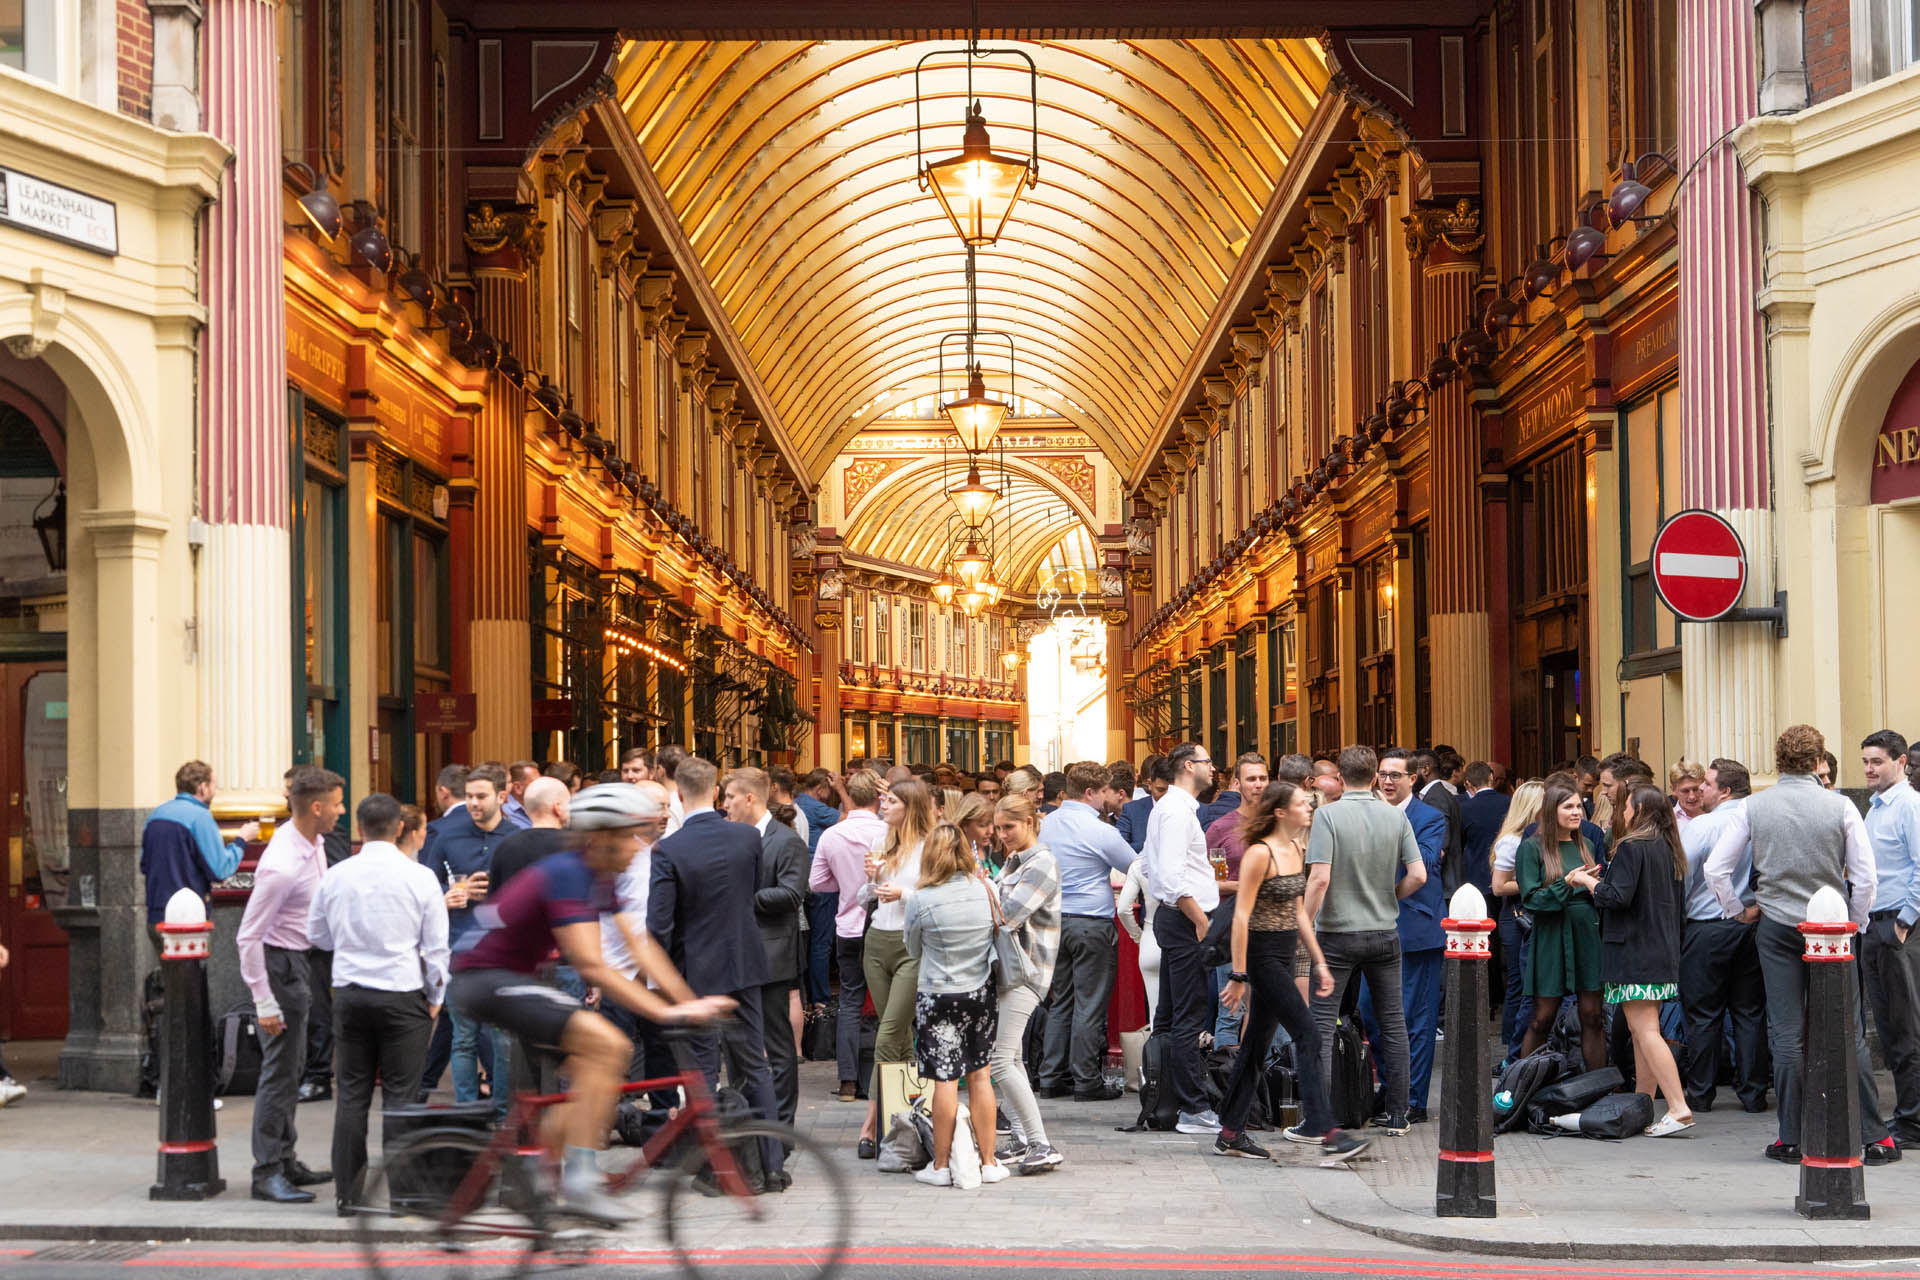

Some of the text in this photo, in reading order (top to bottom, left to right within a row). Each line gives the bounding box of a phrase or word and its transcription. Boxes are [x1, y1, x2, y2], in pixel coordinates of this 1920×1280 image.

[18, 182, 96, 221] LEADENHALL
[20, 202, 71, 231] MARKET
[1636, 314, 1677, 365] PREMIUM
[1519, 381, 1575, 445] NEW MOON
